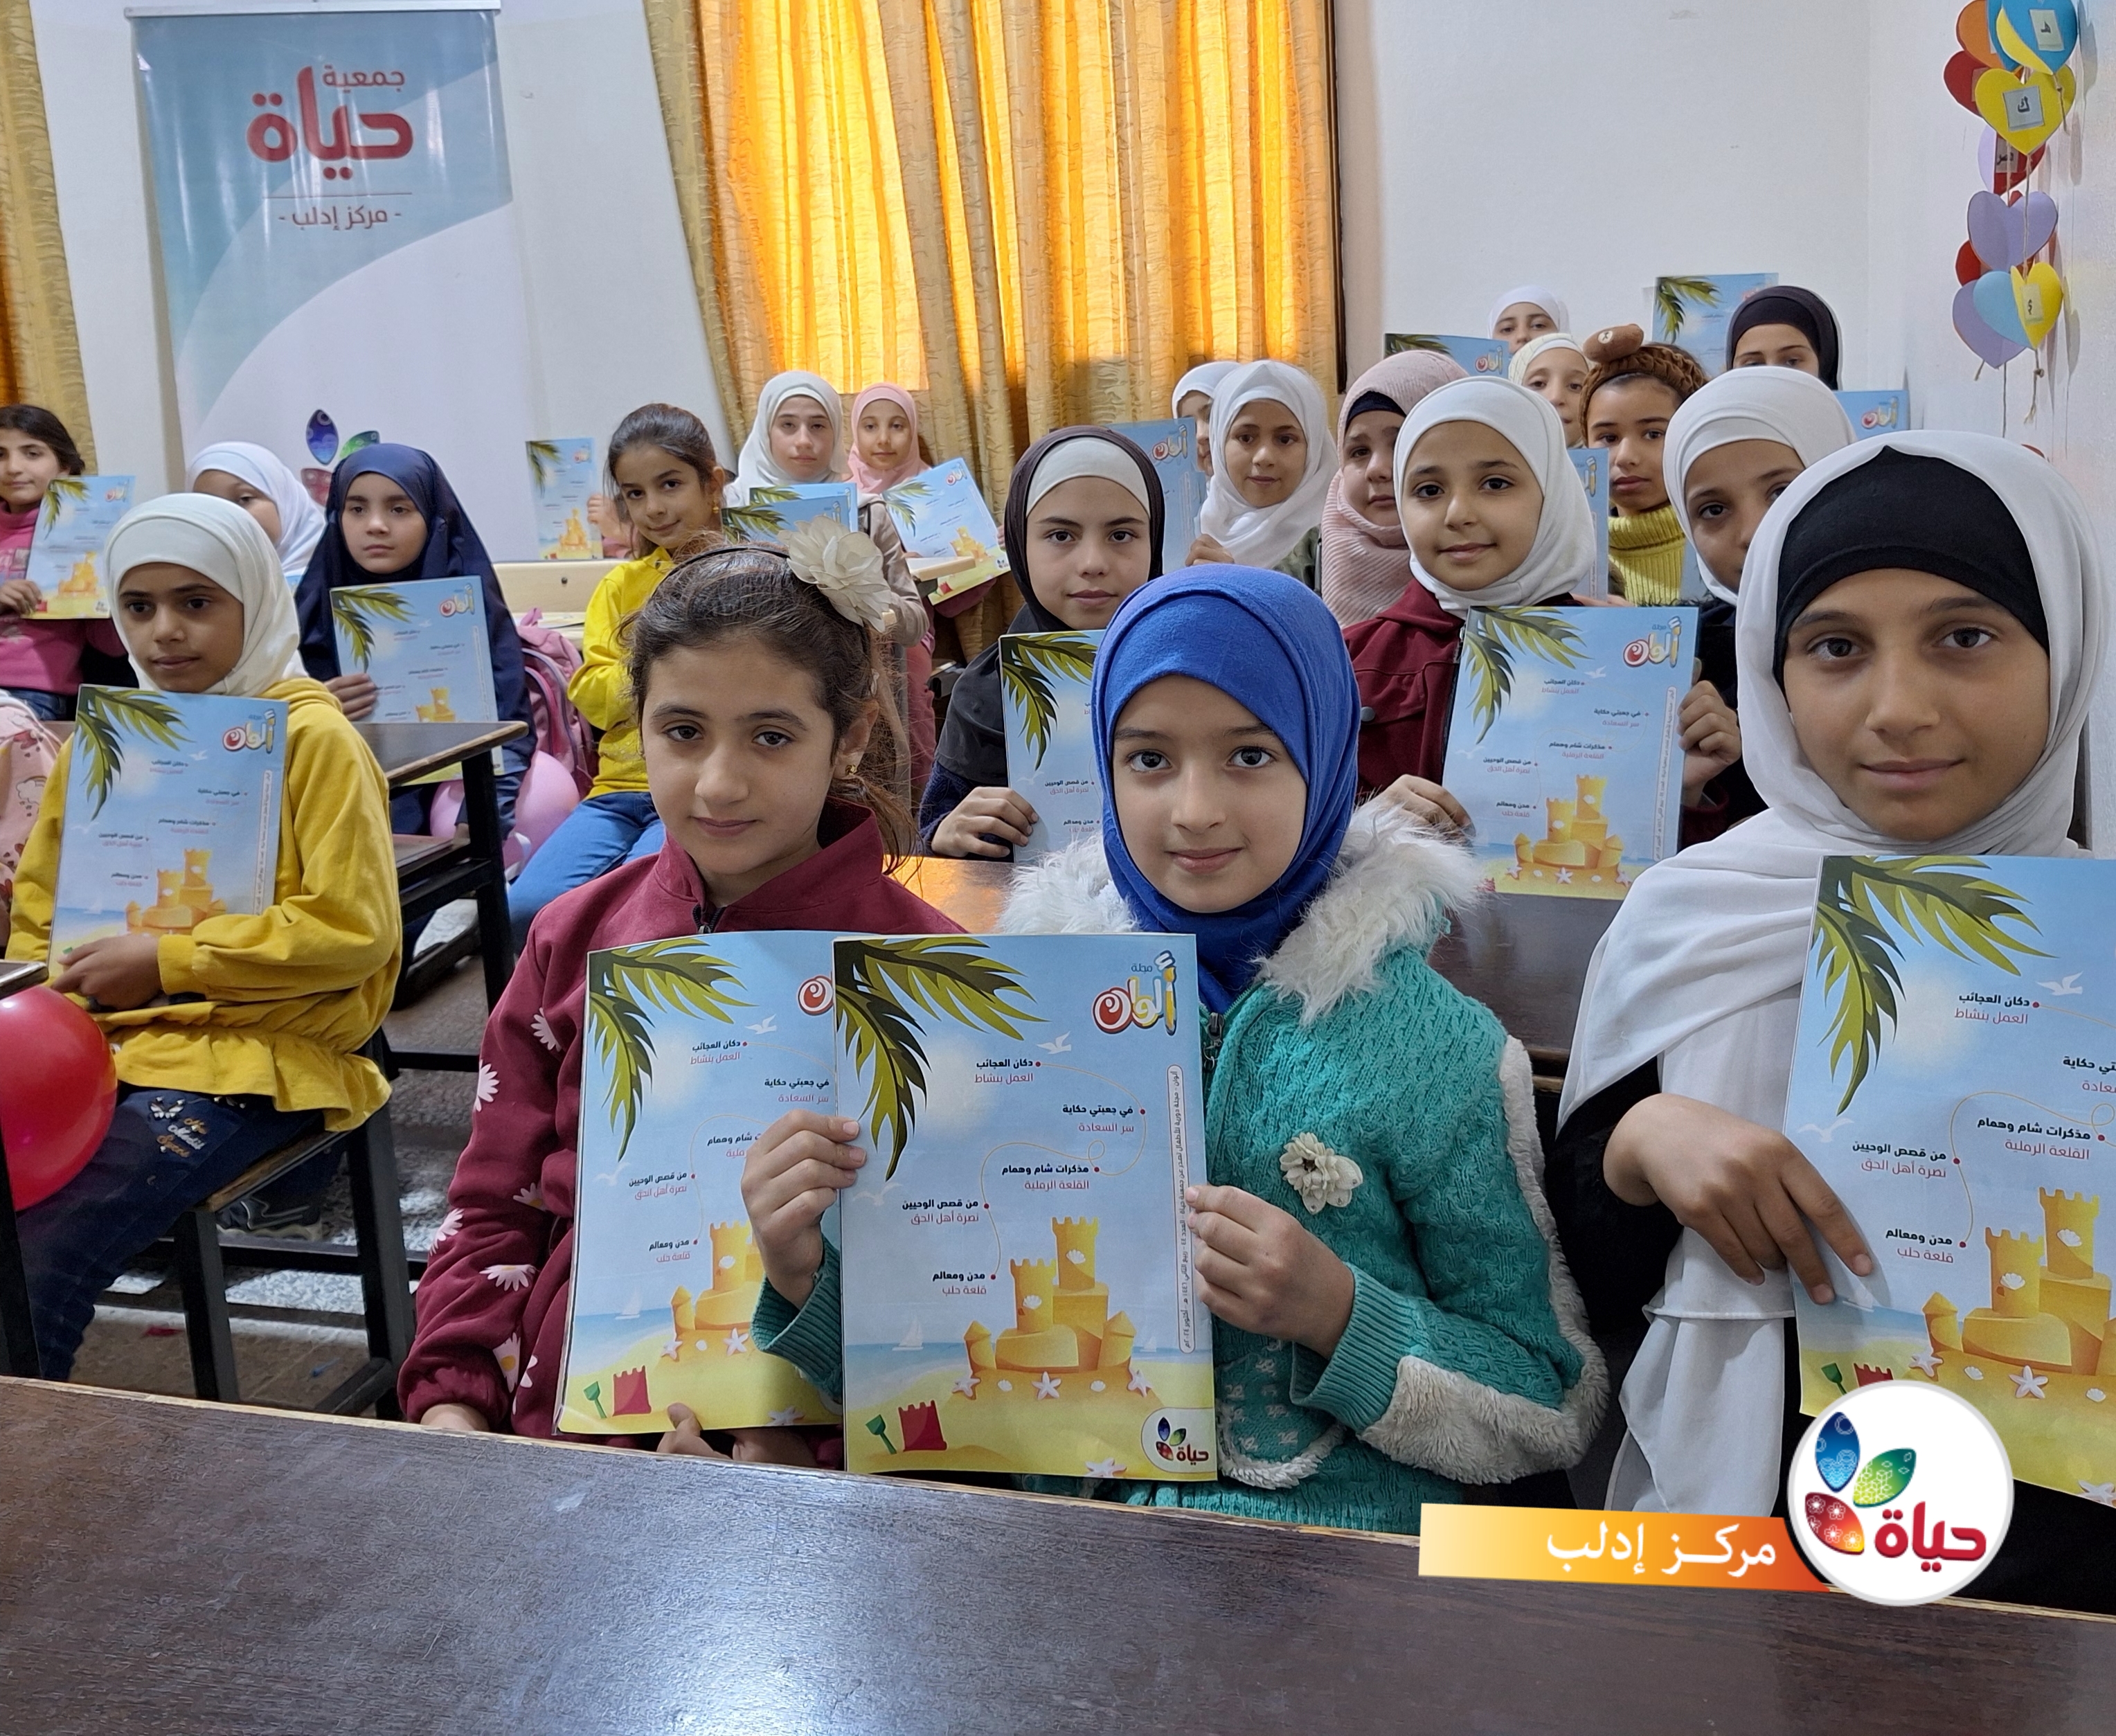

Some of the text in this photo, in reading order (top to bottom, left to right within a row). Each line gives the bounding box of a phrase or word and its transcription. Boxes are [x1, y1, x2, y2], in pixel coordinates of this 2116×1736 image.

[323, 64, 405, 93] جمعية
[246, 66, 413, 180] حياة
[292, 204, 388, 231] مركز إدلب
[1622, 615, 1682, 669] ألوان
[222, 708, 276, 755] ألوان
[1131, 963, 1153, 974] مجلة
[1092, 949, 1177, 1036] ألوان
[1959, 992, 2029, 1008] دكان العجائب
[1955, 1008, 2028, 1024] العمل بنشاط
[692, 1039, 741, 1053] دكان العجائب
[690, 1052, 740, 1065] العمل بنشاط
[976, 1059, 1033, 1069] دكان العجائب
[2063, 1056, 2095, 1069] حكاية
[764, 1078, 830, 1090] في جعبتي حكاية
[974, 1073, 1033, 1085] العمل بنشاط
[2082, 1080, 2116, 1093] عادة
[778, 1093, 829, 1105] سر السعادة
[1062, 1104, 1133, 1118] في جعبتي حكاية
[1079, 1122, 1134, 1135] سر السعادة
[1977, 1118, 2090, 1140] مذكرات شام وهمام
[707, 1136, 733, 1146] وهمام
[735, 1131, 752, 1144] شام
[726, 1148, 746, 1158] ملية
[1852, 1140, 1946, 1161] من قصص الوحيين
[2005, 1138, 2090, 1160] القلعة الرملية
[1001, 1163, 1089, 1175] مذكرات شام وهمام
[1861, 1158, 1946, 1179] نصرة أهل الحق
[629, 1172, 687, 1187] من قصص الوحيين
[1024, 1180, 1089, 1192] القلعة الرملية
[634, 1183, 687, 1201] نصرة أهل الحق
[902, 1199, 978, 1210] من قصص الوحيين
[911, 1210, 979, 1226] نصرة أهل الحق
[1885, 1228, 1953, 1246] مدن ومعالم
[649, 1239, 690, 1251] مدن ومعالم
[1897, 1246, 1953, 1263] قلعة حلب
[932, 1271, 985, 1282] مدن ومعالم
[942, 1285, 987, 1297] قلعة حلب
[1176, 1443, 1209, 1466] حياة
